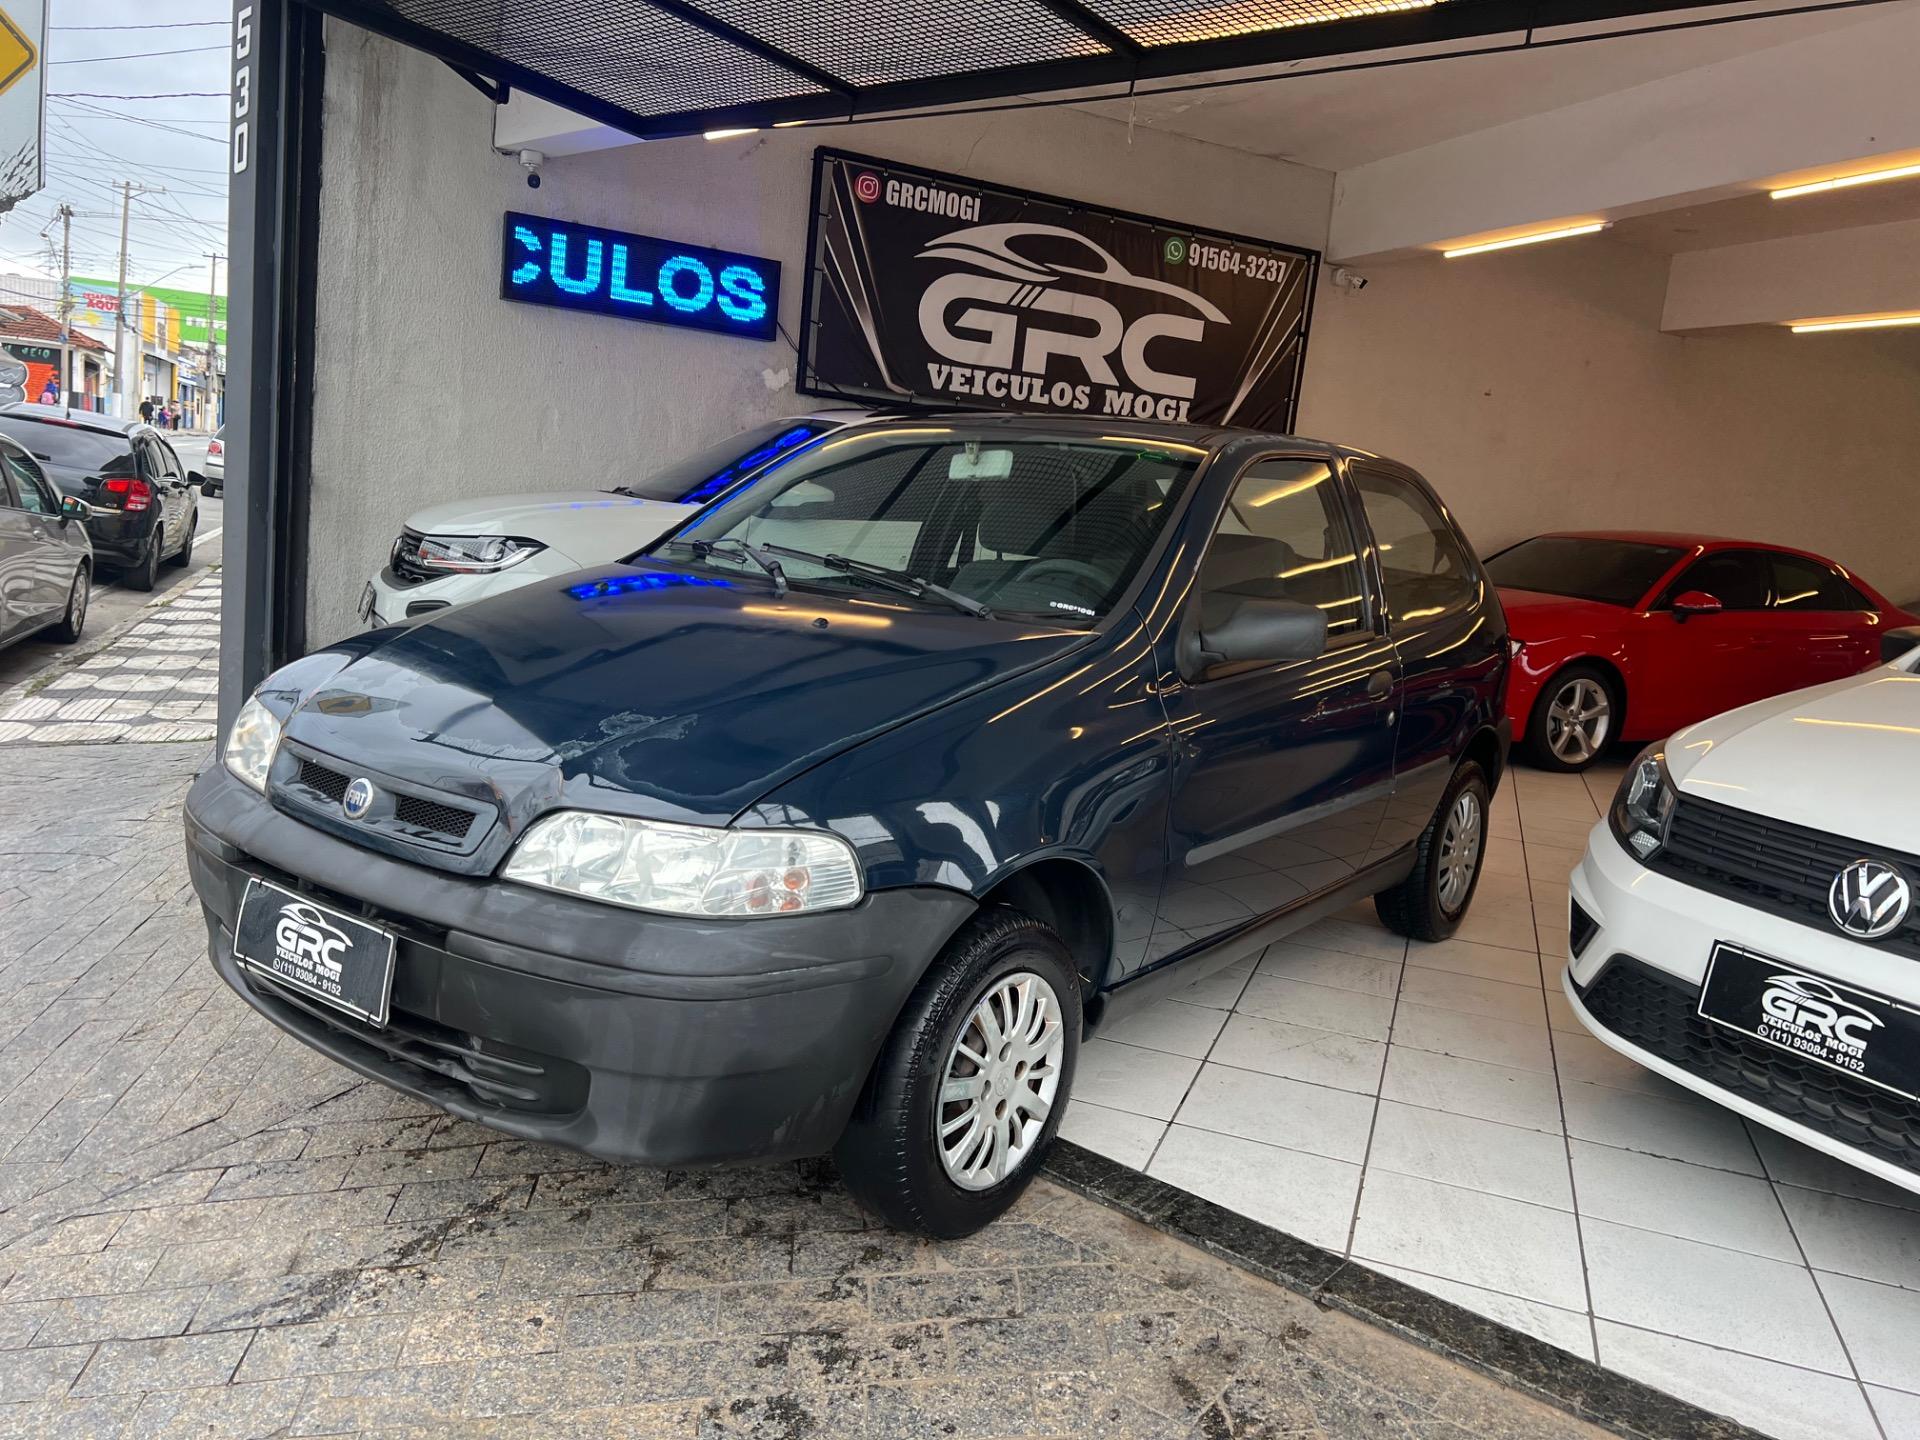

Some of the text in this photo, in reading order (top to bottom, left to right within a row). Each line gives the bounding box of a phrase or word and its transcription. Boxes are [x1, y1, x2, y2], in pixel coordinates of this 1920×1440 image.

[234, 6, 252, 174] 530
[885, 178, 981, 222] GRCMOGI
[1188, 243, 1287, 283] 91564-3237
[918, 272, 1205, 399] GRC
[927, 362, 1191, 423] VEICULOS MOGI
[276, 918, 346, 972] GRC
[276, 946, 340, 982] VEICULOS MOGI
[281, 961, 295, 977] (11)
[1762, 987, 1873, 1050] GRC
[1762, 1013, 1864, 1059] VEICULOS MOGI
[1770, 1027, 1792, 1047] (11)
[1793, 1036, 1828, 1058] 93084
[1835, 1053, 1865, 1072] 9152
